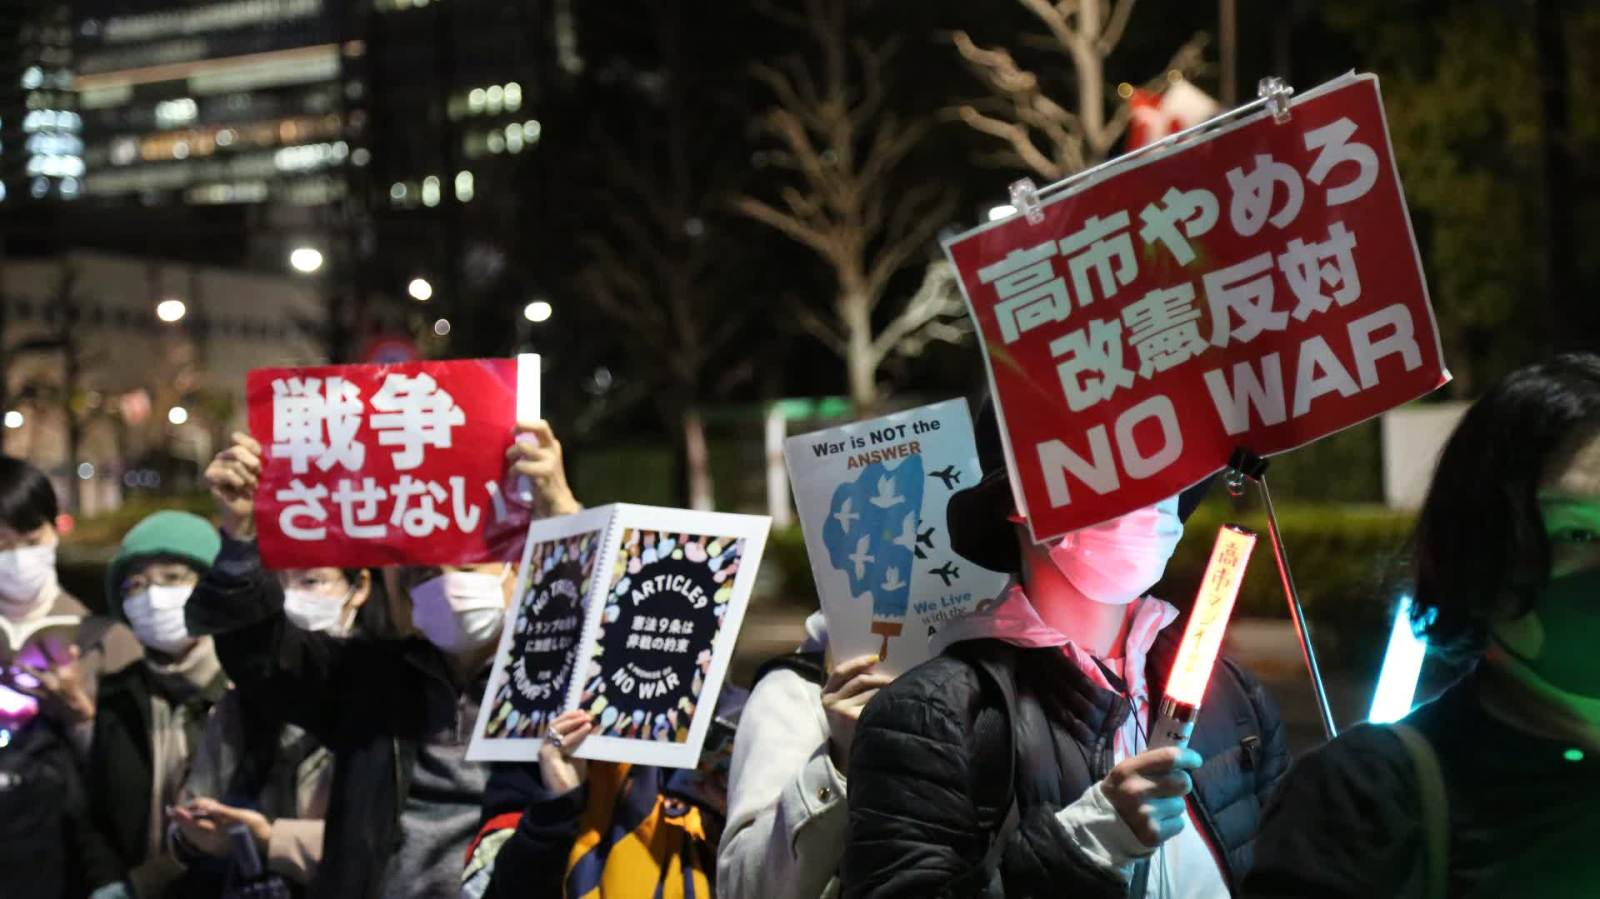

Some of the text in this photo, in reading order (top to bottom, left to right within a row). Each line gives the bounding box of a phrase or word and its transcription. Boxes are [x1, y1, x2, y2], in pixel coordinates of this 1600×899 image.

[977, 116, 1380, 345] 高市やめろ
[1050, 220, 1363, 412] 改憲反対
[271, 372, 466, 474] 戦争
[812, 419, 941, 457] War is NOT the
[1035, 303, 1424, 509] NO WAR
[847, 441, 922, 470] ANSWER
[276, 474, 508, 540] させない
[913, 593, 972, 615] We Live
[611, 667, 635, 694] NO
[639, 672, 680, 699] WAR
